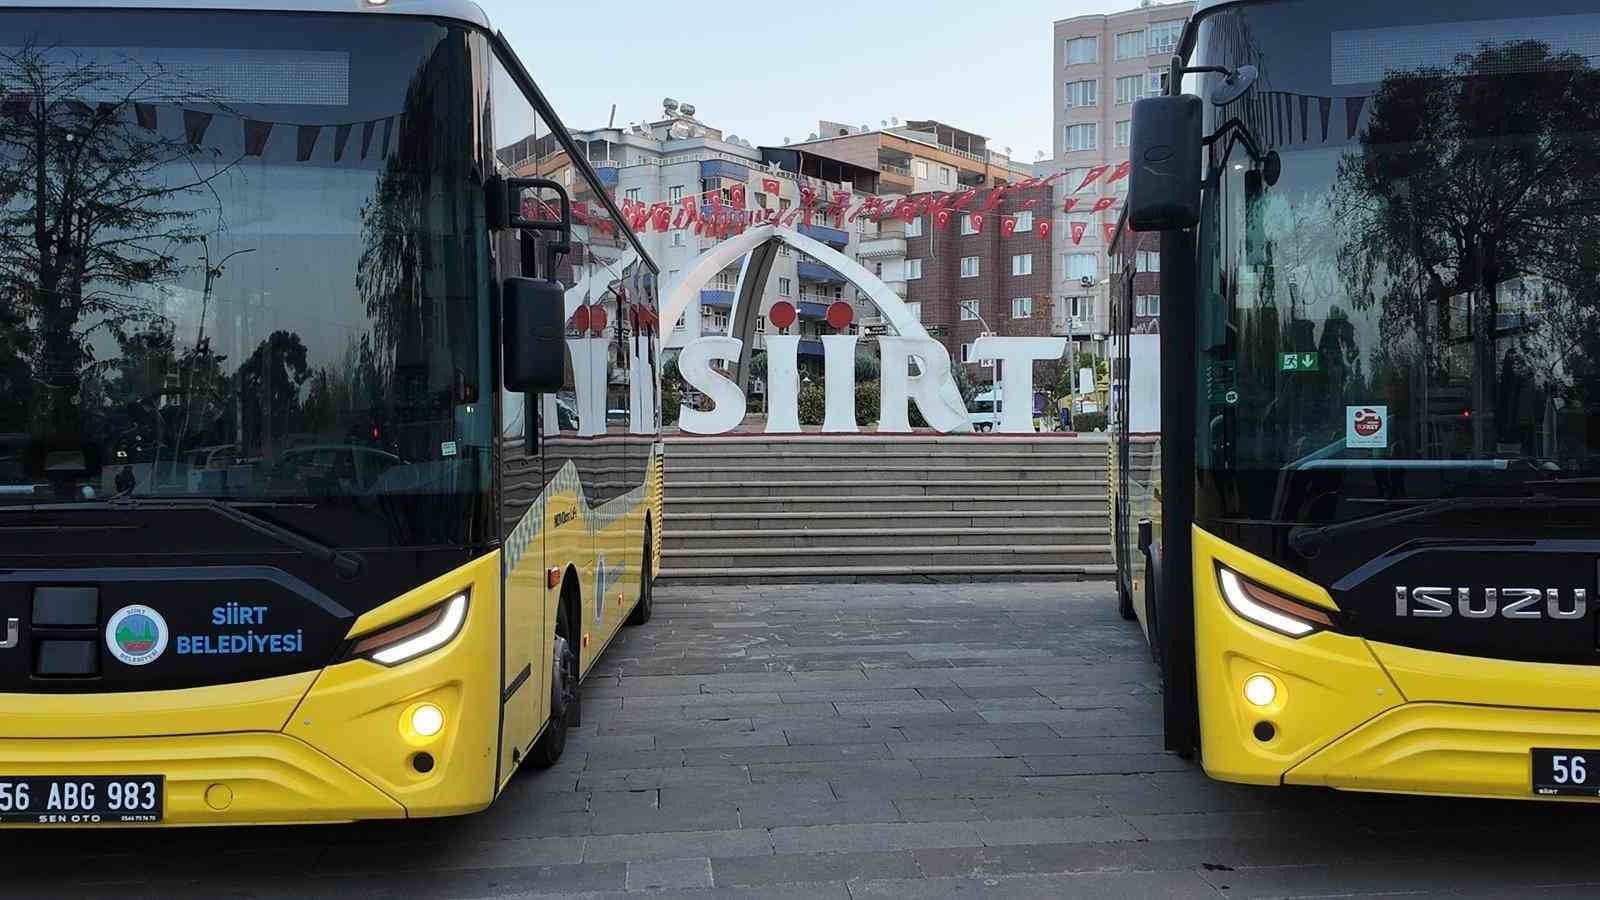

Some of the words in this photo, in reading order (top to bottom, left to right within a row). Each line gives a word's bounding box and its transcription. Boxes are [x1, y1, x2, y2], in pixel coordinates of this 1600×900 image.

[1396, 586, 1586, 619] ISUZU
[177, 630, 303, 654] BELEDİYESİ
[1553, 755, 1586, 784] 56
[0, 782, 30, 811] 56
[47, 782, 95, 810] ABG
[108, 782, 155, 810] 983
[71, 814, 101, 822] OTO
